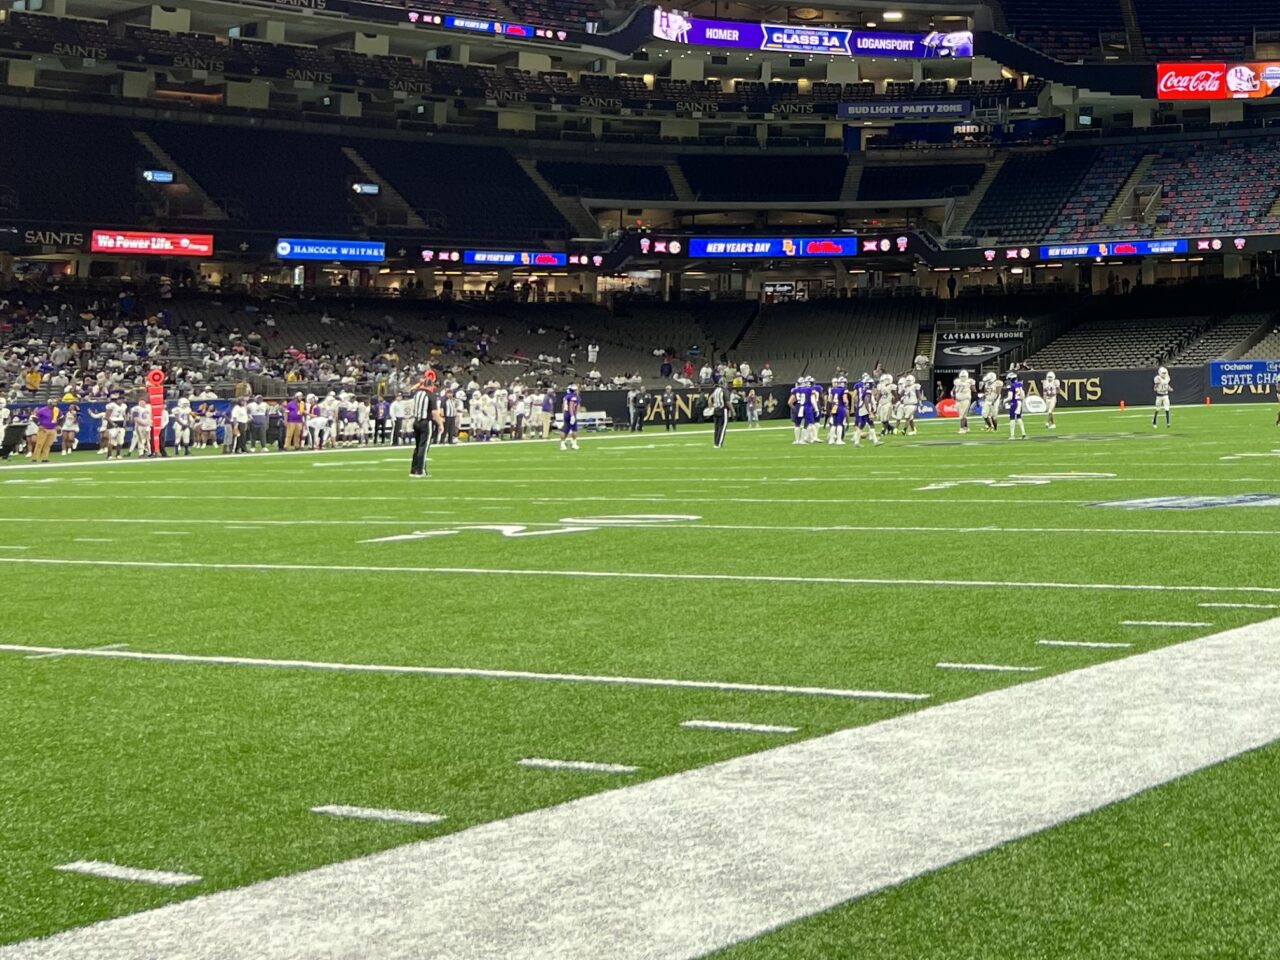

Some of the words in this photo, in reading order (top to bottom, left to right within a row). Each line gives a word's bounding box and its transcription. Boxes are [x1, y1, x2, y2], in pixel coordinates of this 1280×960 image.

[705, 28, 739, 41] HOMER
[772, 33, 820, 45] CLASS
[822, 36, 840, 47] 1A
[857, 37, 915, 51] LOGANSPORT
[53, 43, 107, 59] SAINTS
[174, 56, 225, 72] SAINTS
[286, 67, 333, 83] SAINTS
[1160, 70, 1223, 93] Coca-Cola
[388, 80, 432, 93] SAINTS
[484, 89, 527, 102] SAINTS
[579, 96, 623, 109] SAINTS
[676, 101, 719, 112] SAINTS
[771, 104, 814, 114] SAINTS
[848, 106, 870, 114] BUD
[870, 105, 899, 114] LIGHT
[902, 104, 936, 113] PARTY
[937, 104, 963, 112] ZONE
[25, 229, 84, 246] SAINTS
[97, 234, 114, 247] We
[115, 235, 150, 249] Power
[293, 245, 338, 255] HANCOCK
[341, 247, 385, 258] WHITNEY
[705, 242, 726, 253] NEW
[726, 242, 754, 254] YEAR'S
[754, 242, 771, 253] DAY
[942, 331, 981, 341] CAESARS
[981, 331, 1024, 340] SUPERDOME
[1224, 363, 1253, 372] Ochsner
[1221, 374, 1254, 385] STATE
